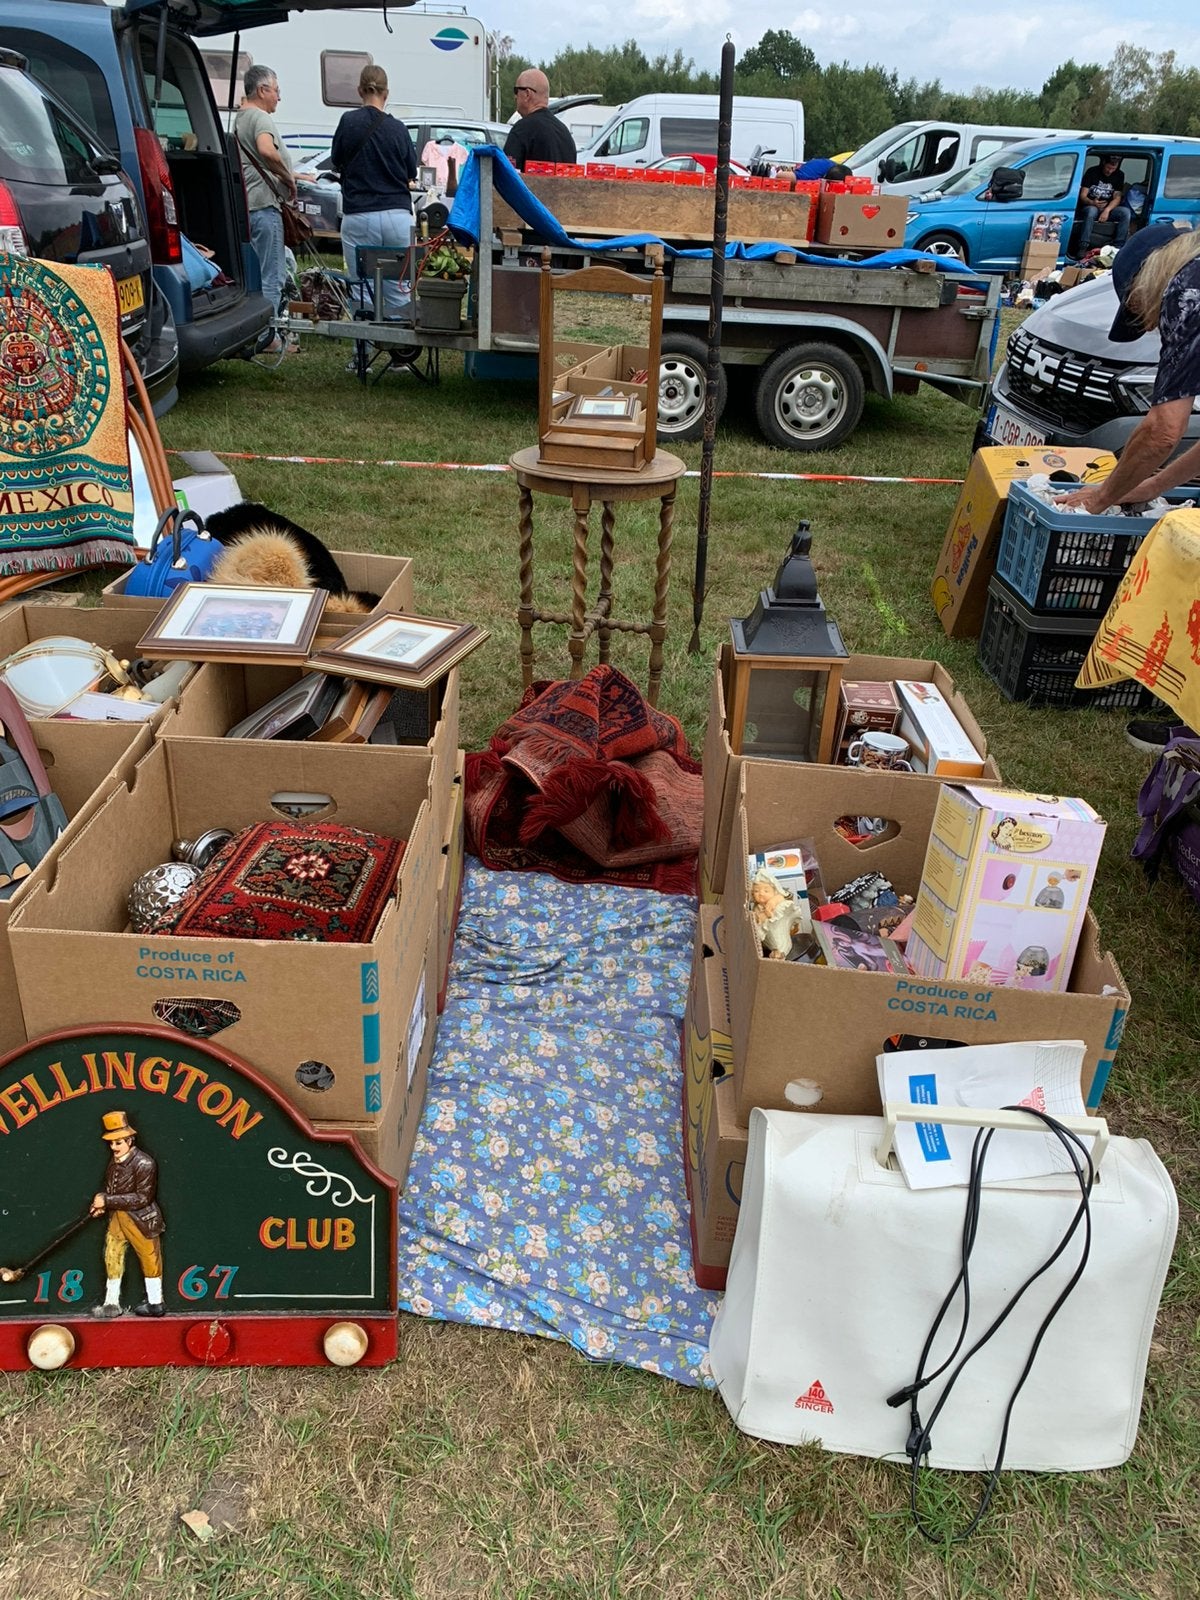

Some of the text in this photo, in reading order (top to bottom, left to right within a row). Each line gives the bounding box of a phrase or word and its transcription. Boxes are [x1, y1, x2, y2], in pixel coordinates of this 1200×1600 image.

[139, 947, 235, 964] Produce of
[136, 965, 247, 982] COSTA RICA
[896, 980, 993, 1003] Produce of
[887, 997, 998, 1022] COSTA RICA
[0, 1051, 264, 1140] ELLINGTON
[259, 1216, 356, 1251] CLUB
[34, 1264, 239, 1303] 18 67
[808, 1386, 825, 1399] 140
[794, 1401, 834, 1414] SINGER
